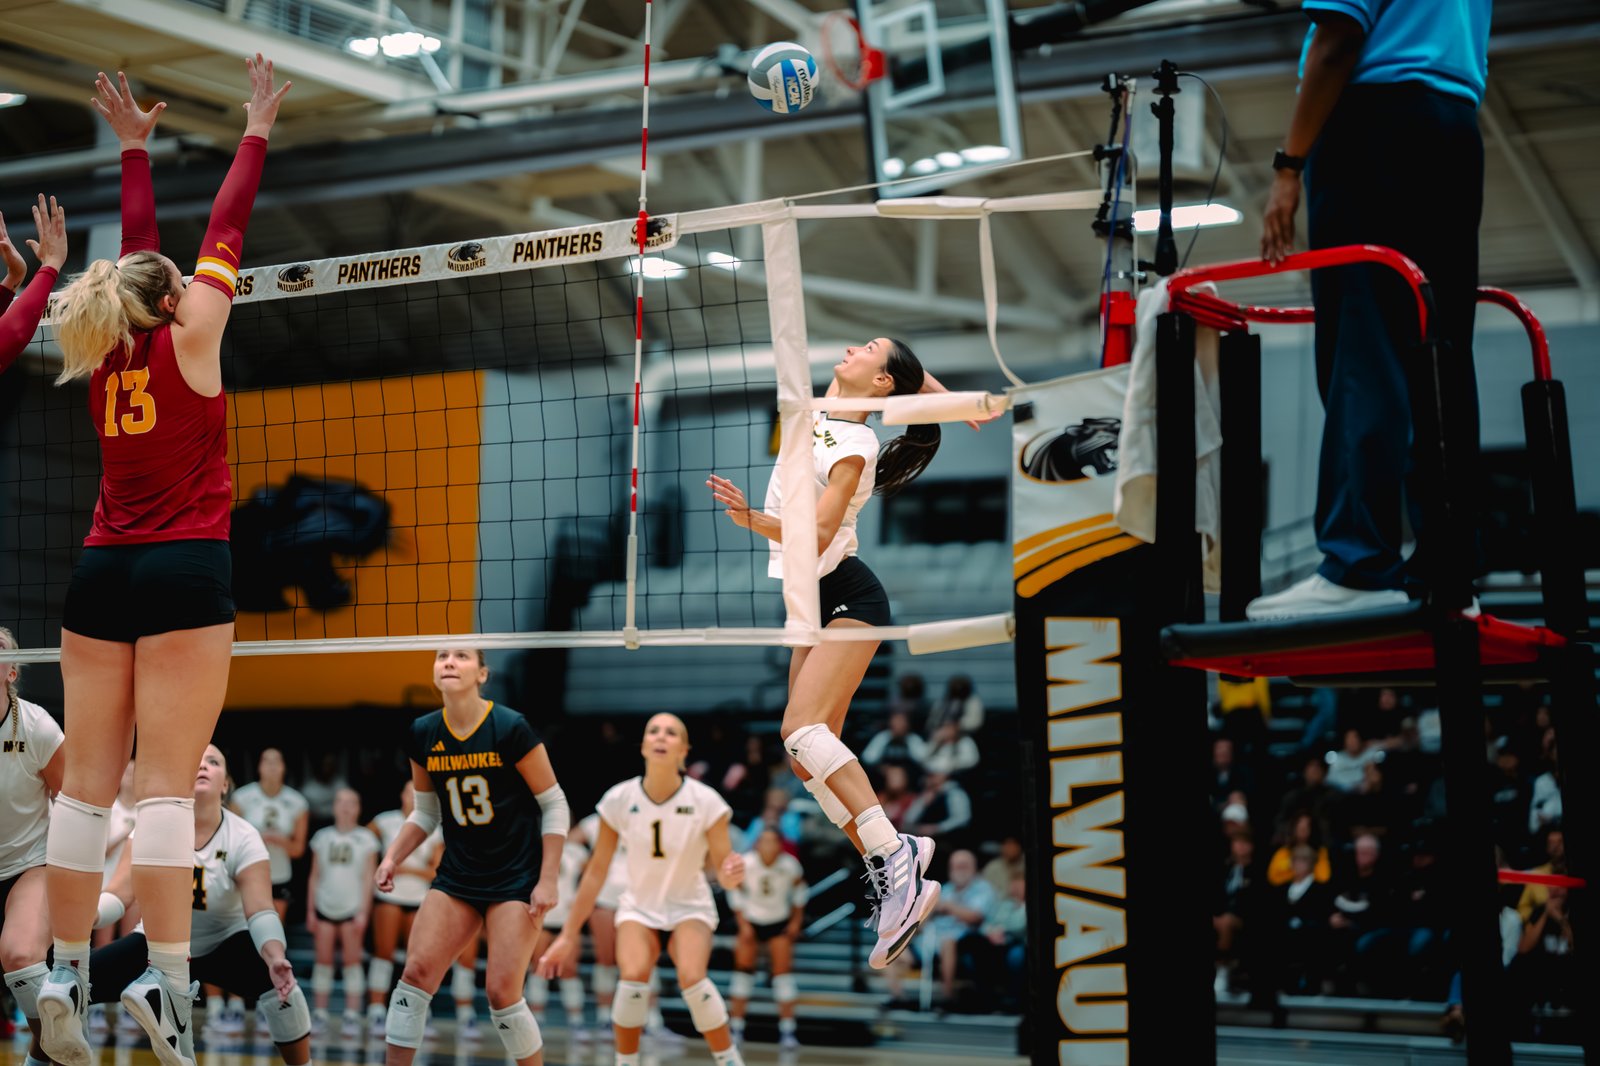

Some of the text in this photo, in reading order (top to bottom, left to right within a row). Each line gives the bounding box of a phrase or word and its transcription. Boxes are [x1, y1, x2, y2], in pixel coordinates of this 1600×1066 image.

[785, 77, 801, 106] NCAA
[798, 68, 811, 104] molten
[513, 231, 603, 263] PANTHERS
[630, 232, 672, 248] MWAUKEE
[337, 254, 422, 285] PANTHERS
[447, 257, 487, 273] MILWAUKEE
[277, 279, 314, 293] MILWAUKEE
[105, 366, 157, 437] 13
[446, 775, 495, 827] 13
[651, 819, 666, 859] 1
